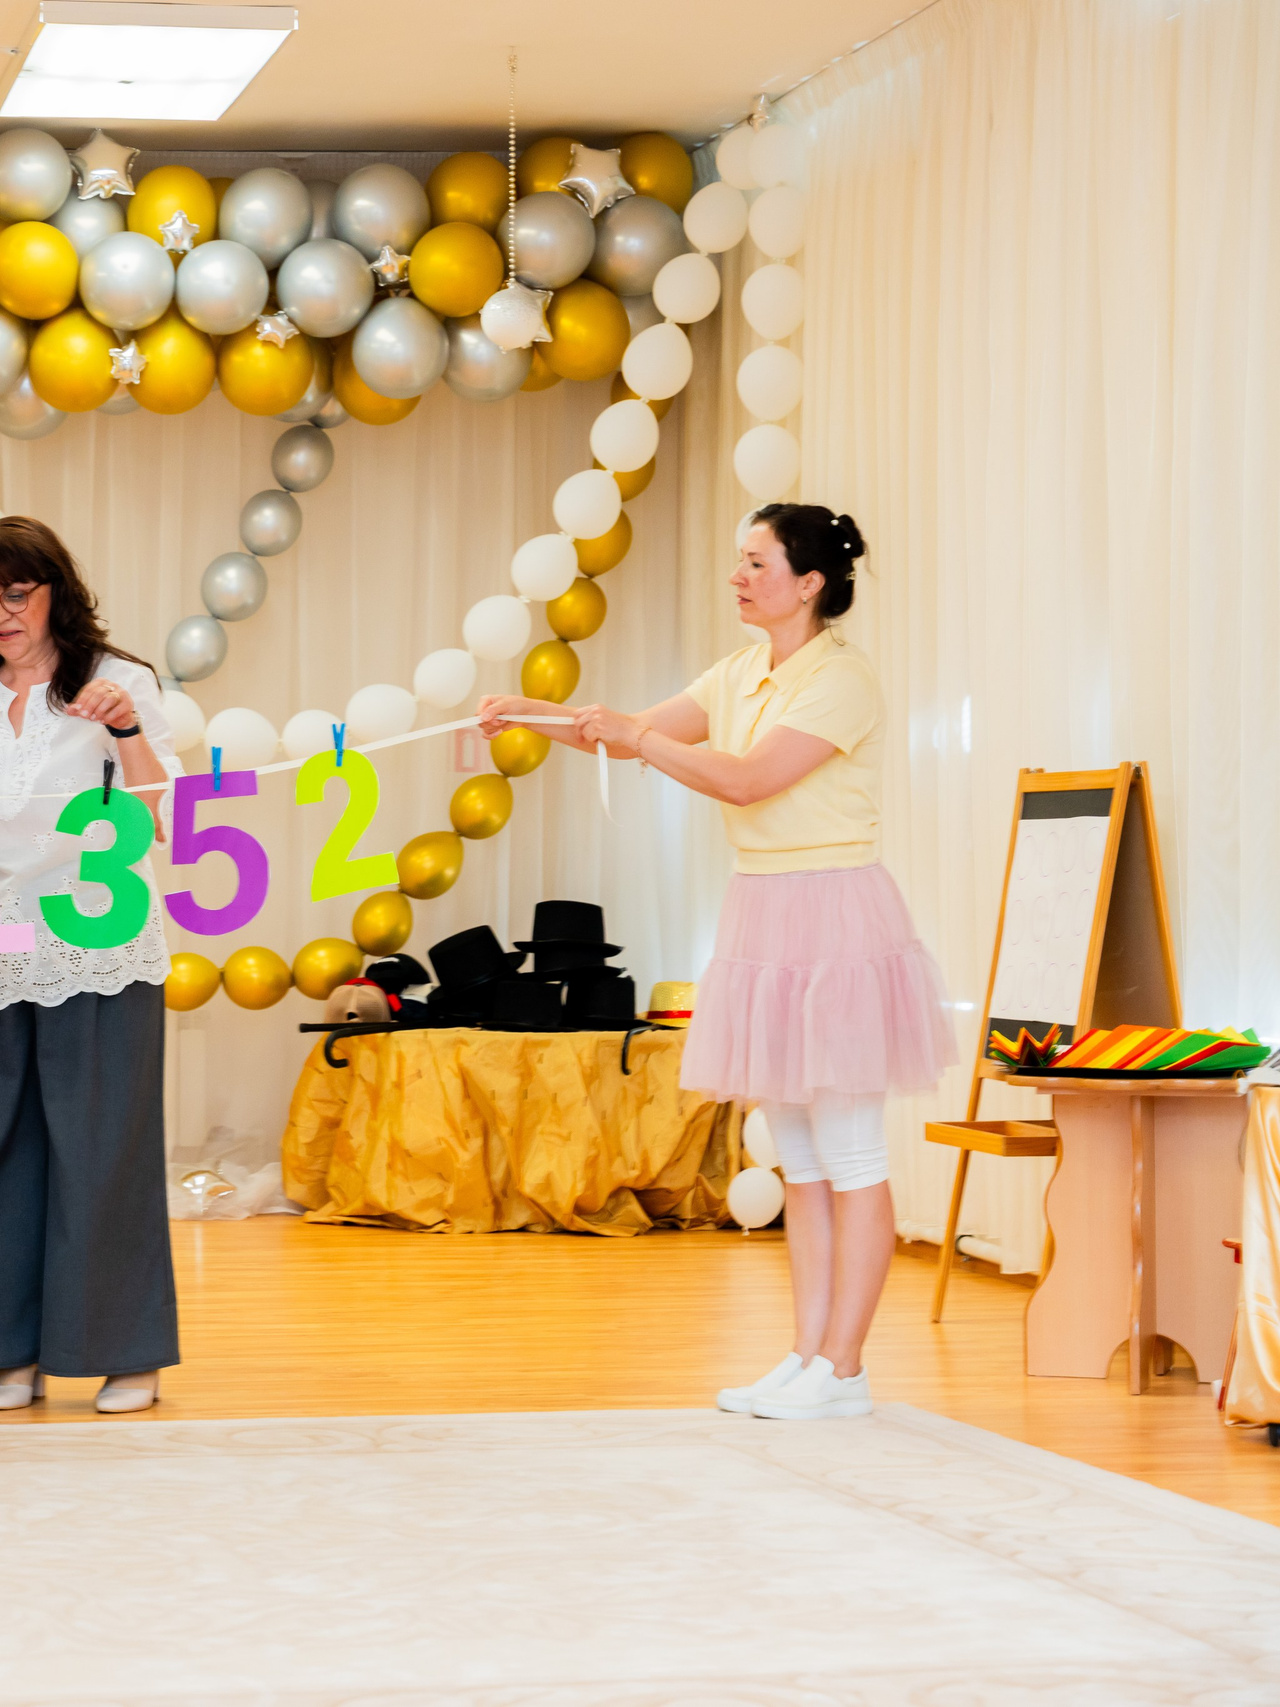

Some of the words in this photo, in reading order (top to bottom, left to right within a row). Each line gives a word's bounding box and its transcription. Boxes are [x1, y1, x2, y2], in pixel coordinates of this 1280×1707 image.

[39, 786, 155, 949] 3
[164, 769, 269, 936] 5
[295, 748, 400, 902] 2
